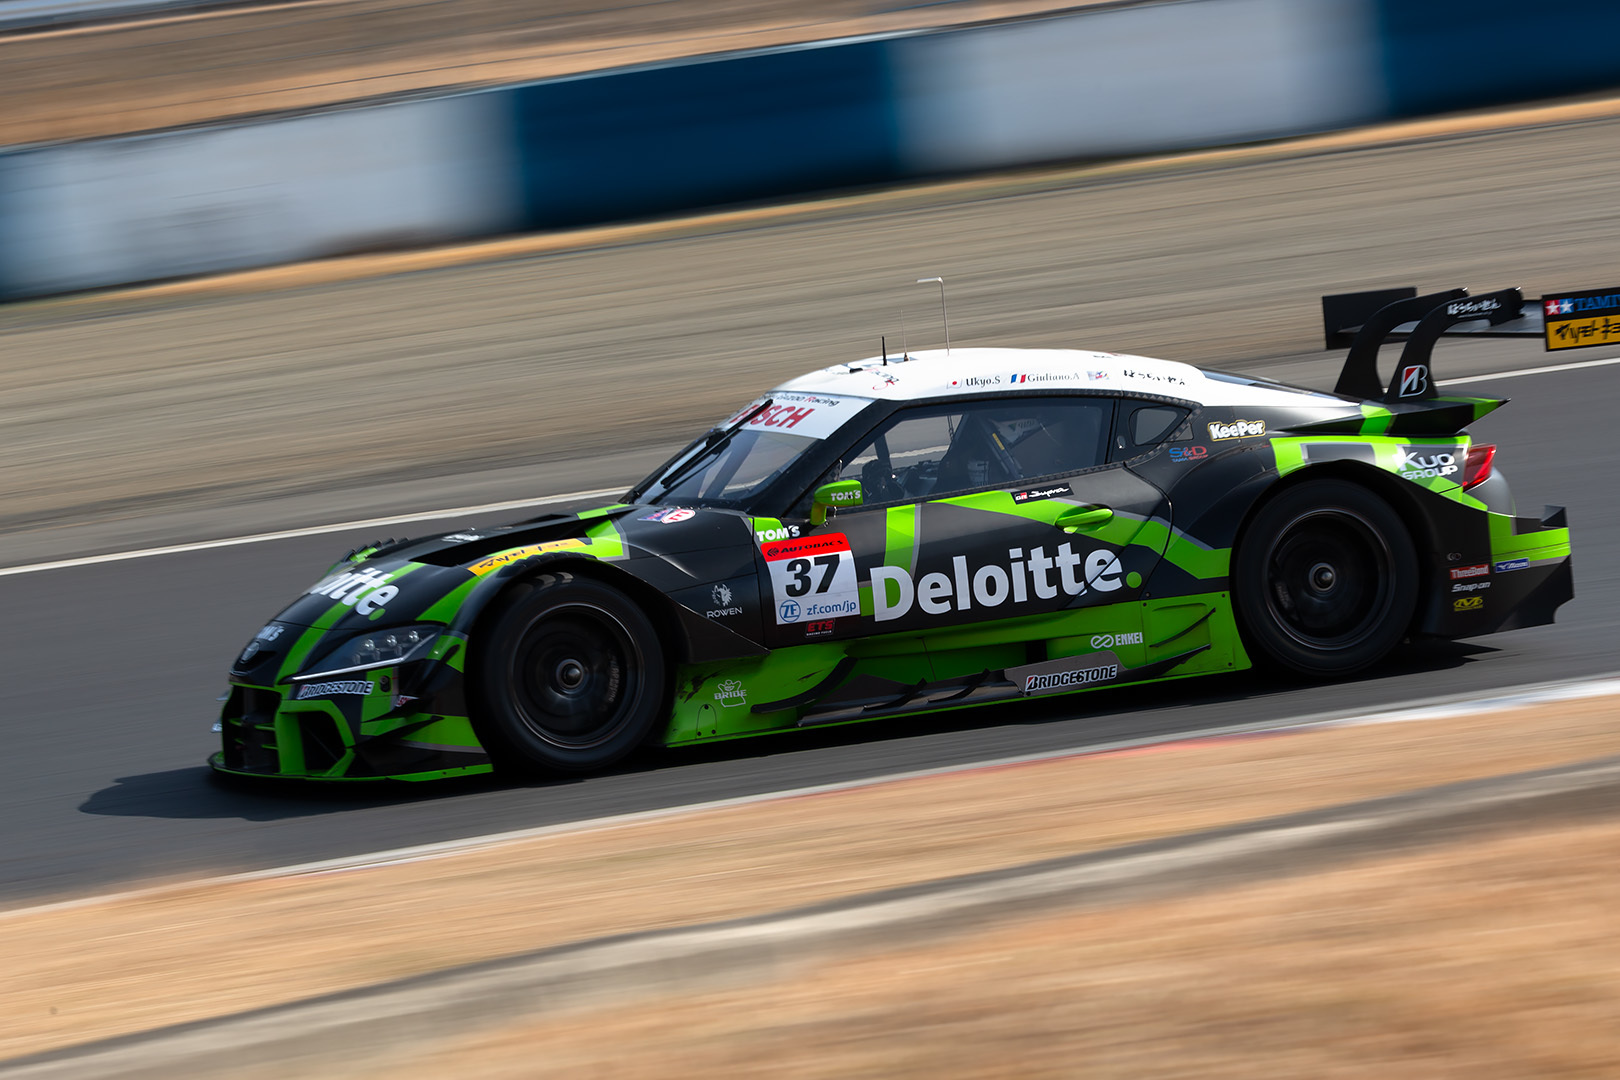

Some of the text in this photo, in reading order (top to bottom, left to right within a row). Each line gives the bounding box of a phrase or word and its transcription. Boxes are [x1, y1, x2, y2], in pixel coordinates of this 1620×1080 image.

[1574, 293, 1620, 311] TAMI
[965, 376, 1001, 388] Ukyo.S
[1027, 372, 1080, 382] Giuliano.A
[804, 396, 840, 407] Racing
[1168, 445, 1208, 458] S&D
[1402, 464, 1459, 480] GROUP
[757, 525, 801, 542] TOM'S
[780, 540, 844, 554] AUTOBACS
[785, 554, 840, 598] 37
[706, 606, 743, 619] ROWEN
[806, 600, 857, 616] zf.com/jp
[807, 620, 834, 632] ETS
[1115, 632, 1143, 646] ENKEI
[1025, 664, 1118, 691] BRIDGESTONE
[296, 680, 374, 699] BRIDGESTONE
[714, 689, 747, 700] BRIDE
